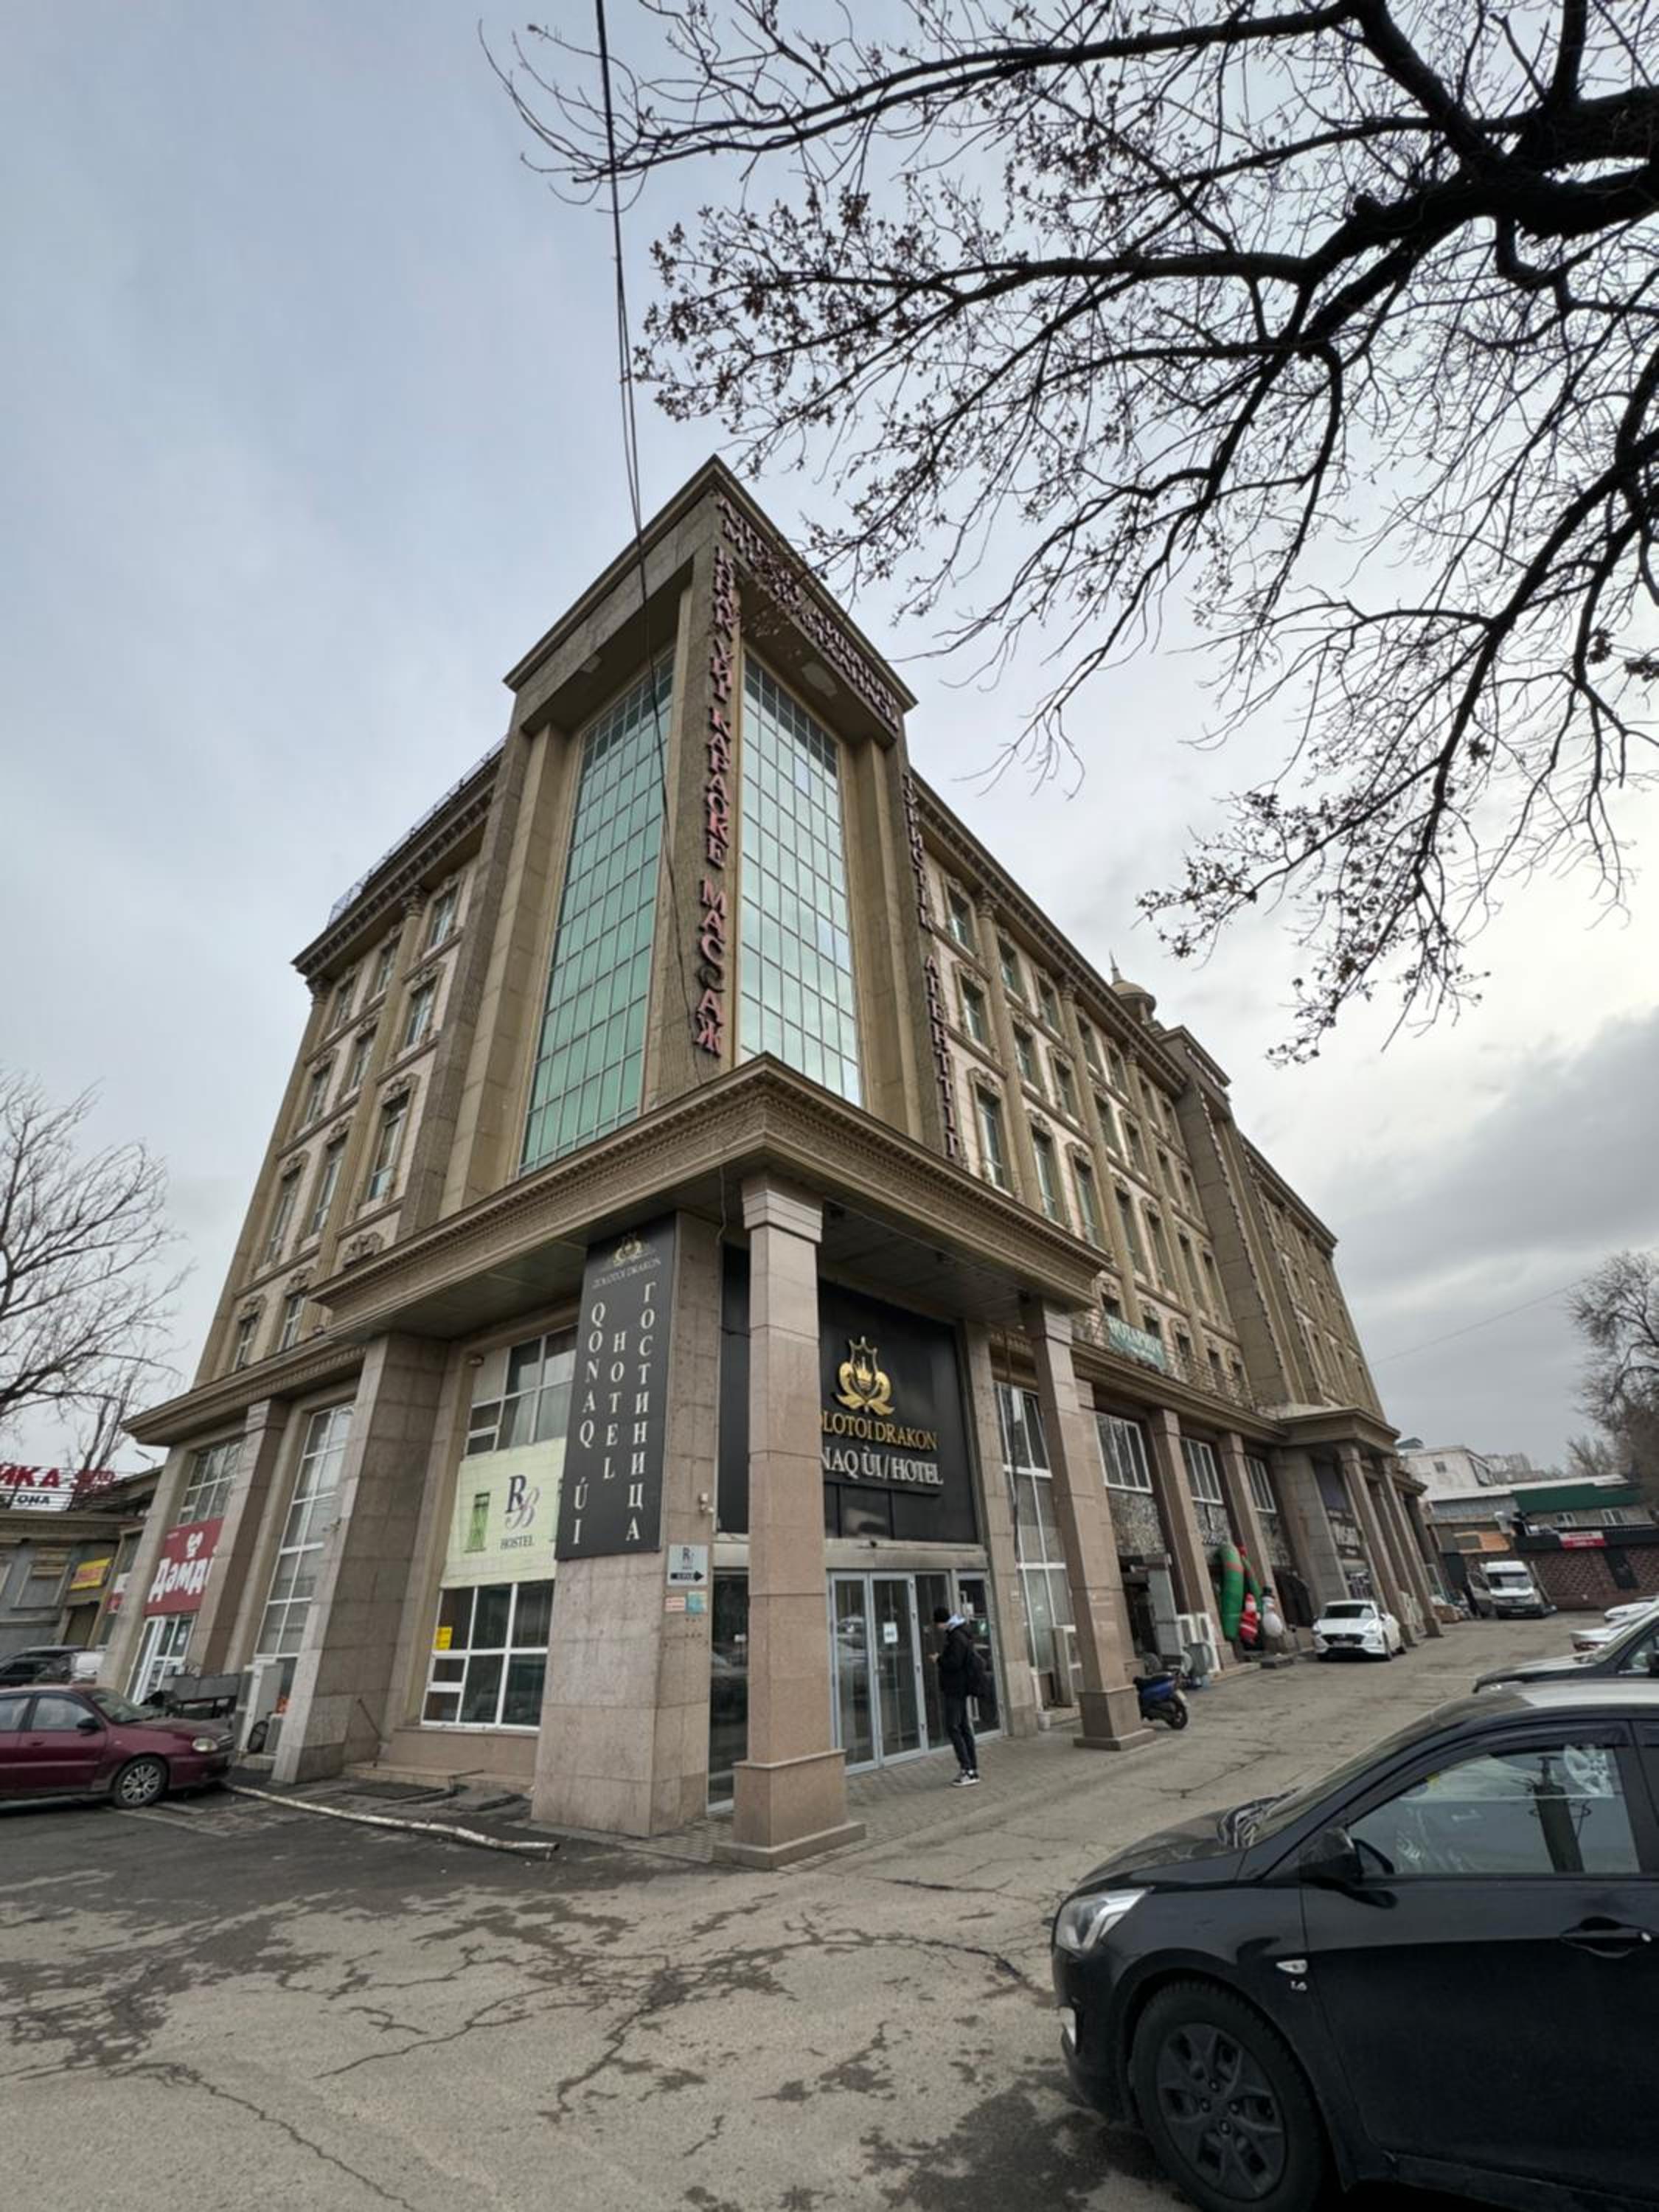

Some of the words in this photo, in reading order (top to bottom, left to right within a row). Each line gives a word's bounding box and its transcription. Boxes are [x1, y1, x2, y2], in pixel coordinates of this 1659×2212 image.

[707, 707, 732, 868] КАРАОКЕ
[698, 880, 727, 1056] МАССАЖ
[579, 1301, 606, 1449] QONAQ
[603, 1330, 627, 1480] HOTEL
[625, 1281, 658, 1542] ГОСТИНИЦА
[820, 1410, 872, 1441] LOTOI
[875, 1422, 939, 1450] DRAKON
[821, 1446, 860, 1480] NAQ
[891, 1457, 944, 1486] HOTEL
[501, 1535, 535, 1550] HOSTEL
